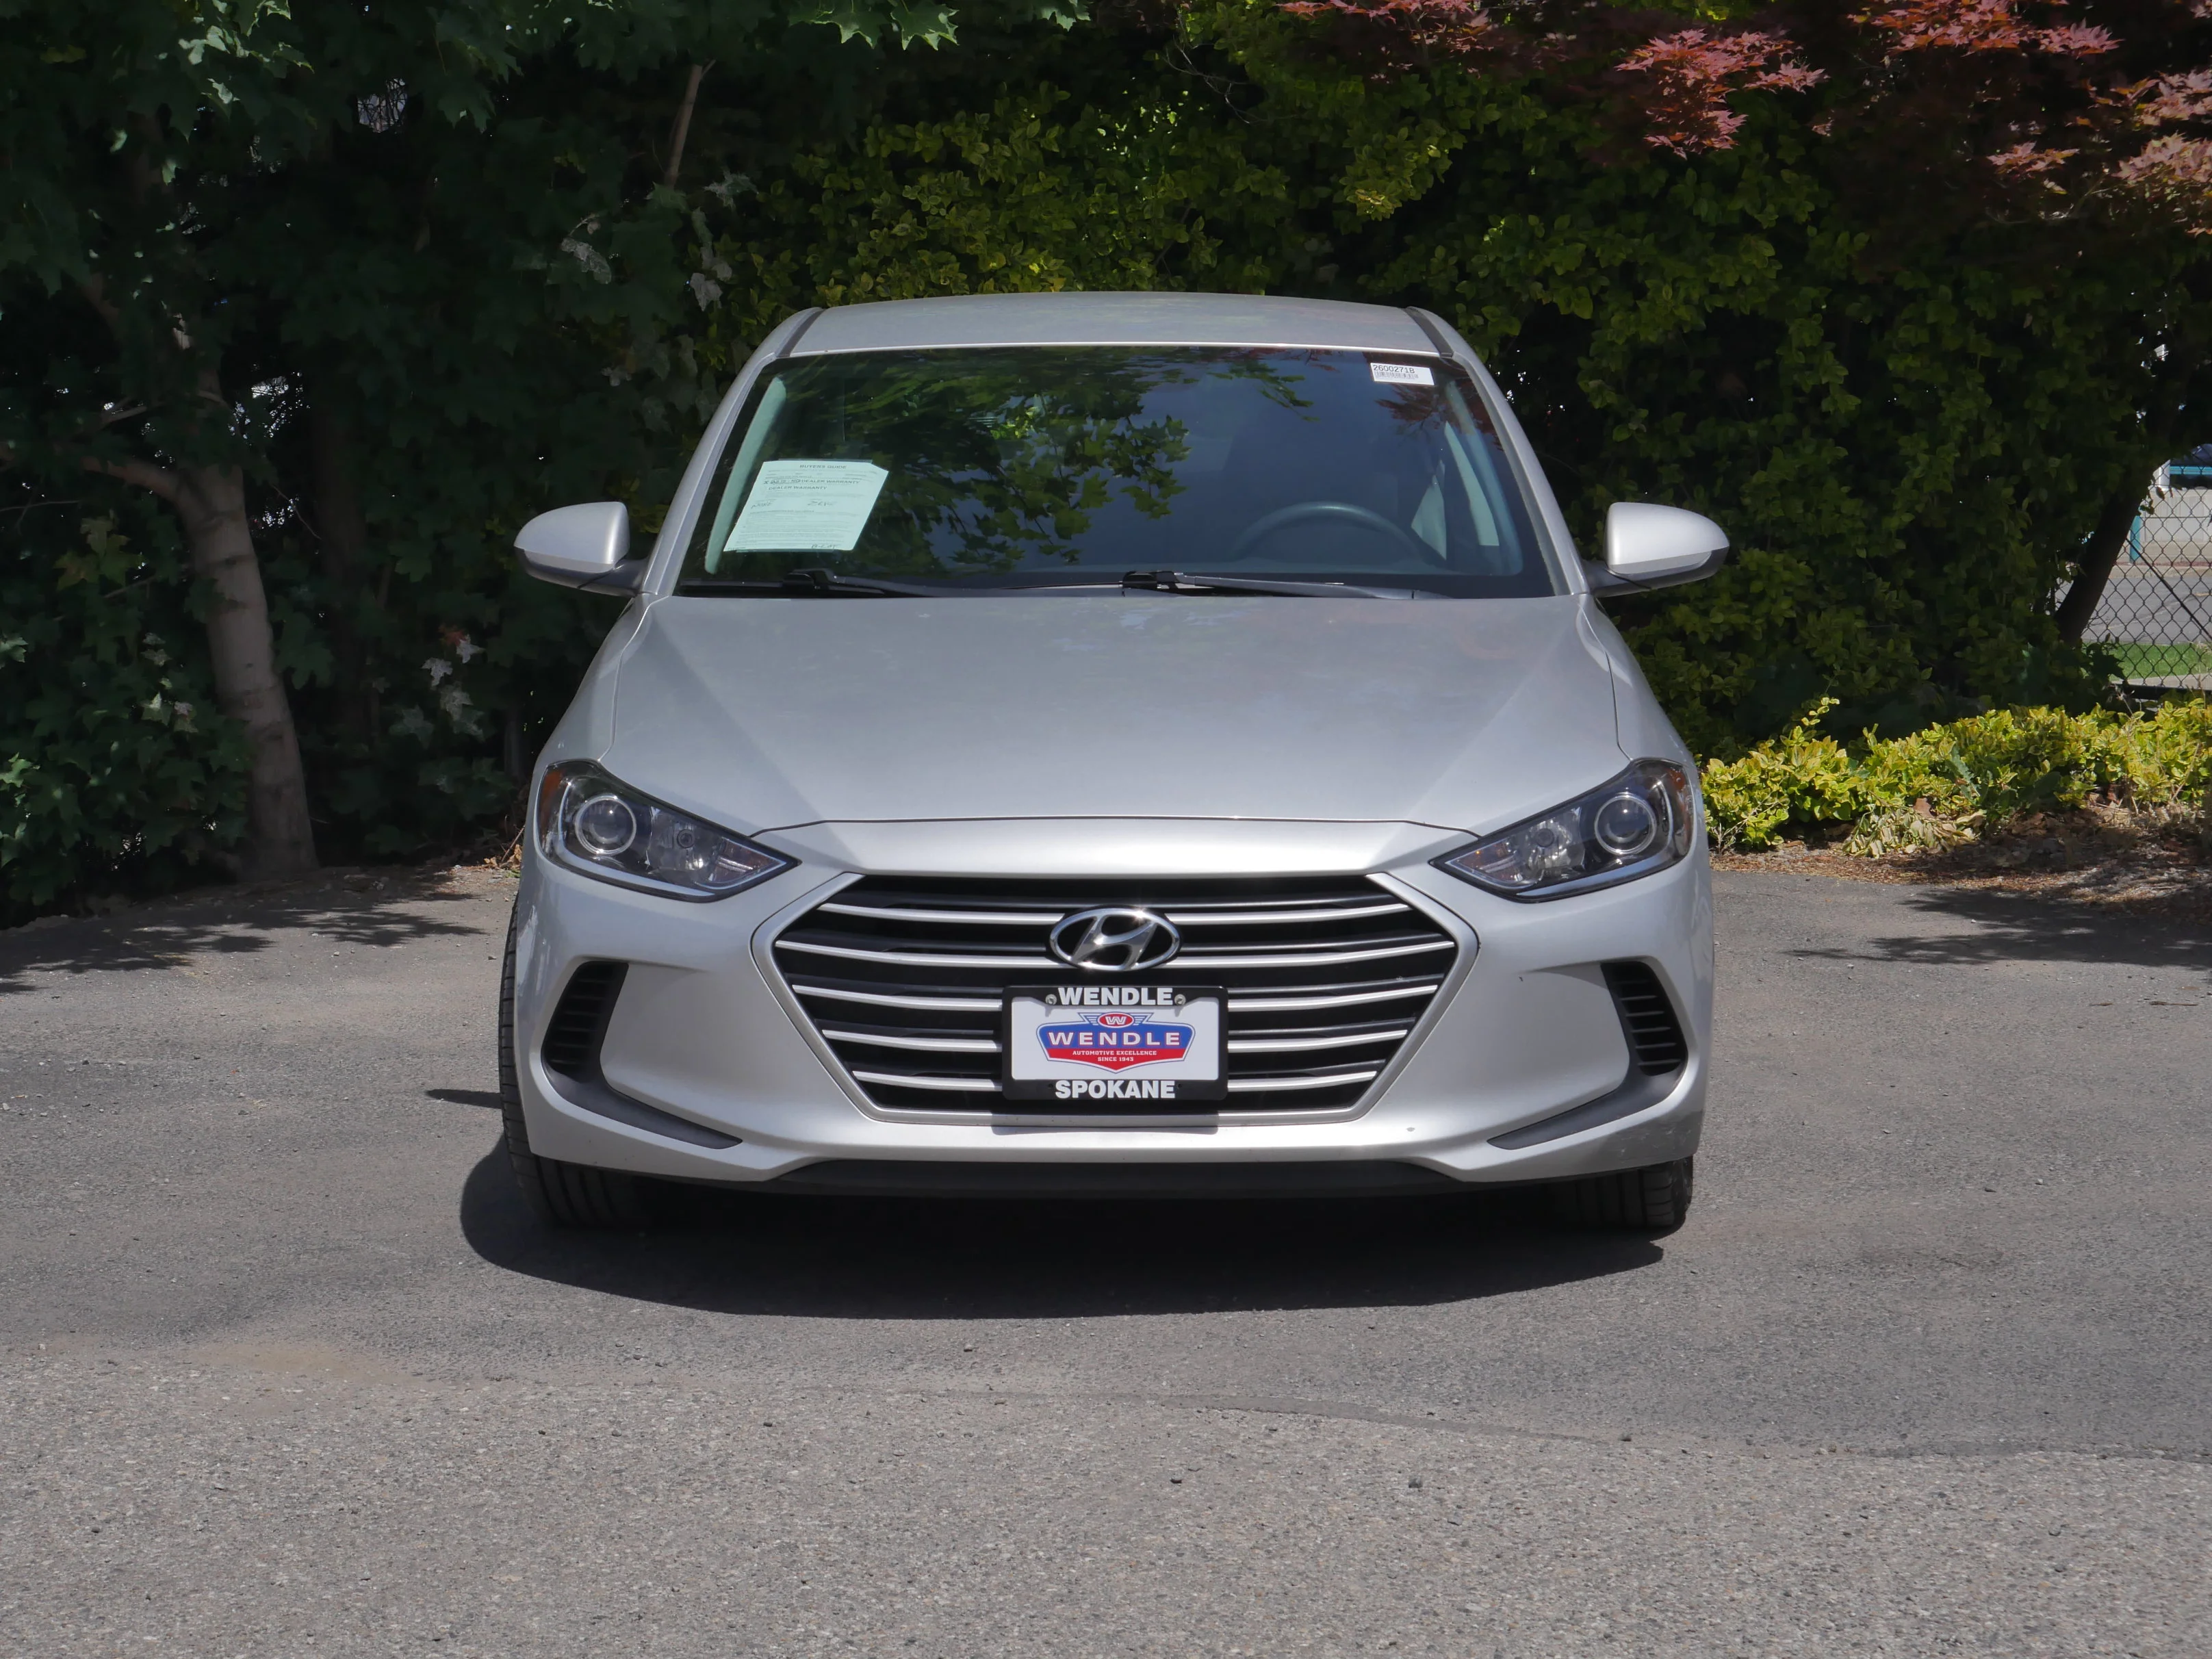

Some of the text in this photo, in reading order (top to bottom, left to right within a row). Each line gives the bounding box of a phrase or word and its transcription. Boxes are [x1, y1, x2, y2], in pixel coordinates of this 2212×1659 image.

[1058, 987, 1173, 1006] WENDLE
[1104, 1016, 1127, 1025] W
[1048, 1031, 1180, 1046] WENDLE
[1055, 1079, 1175, 1098] SPOKANE
